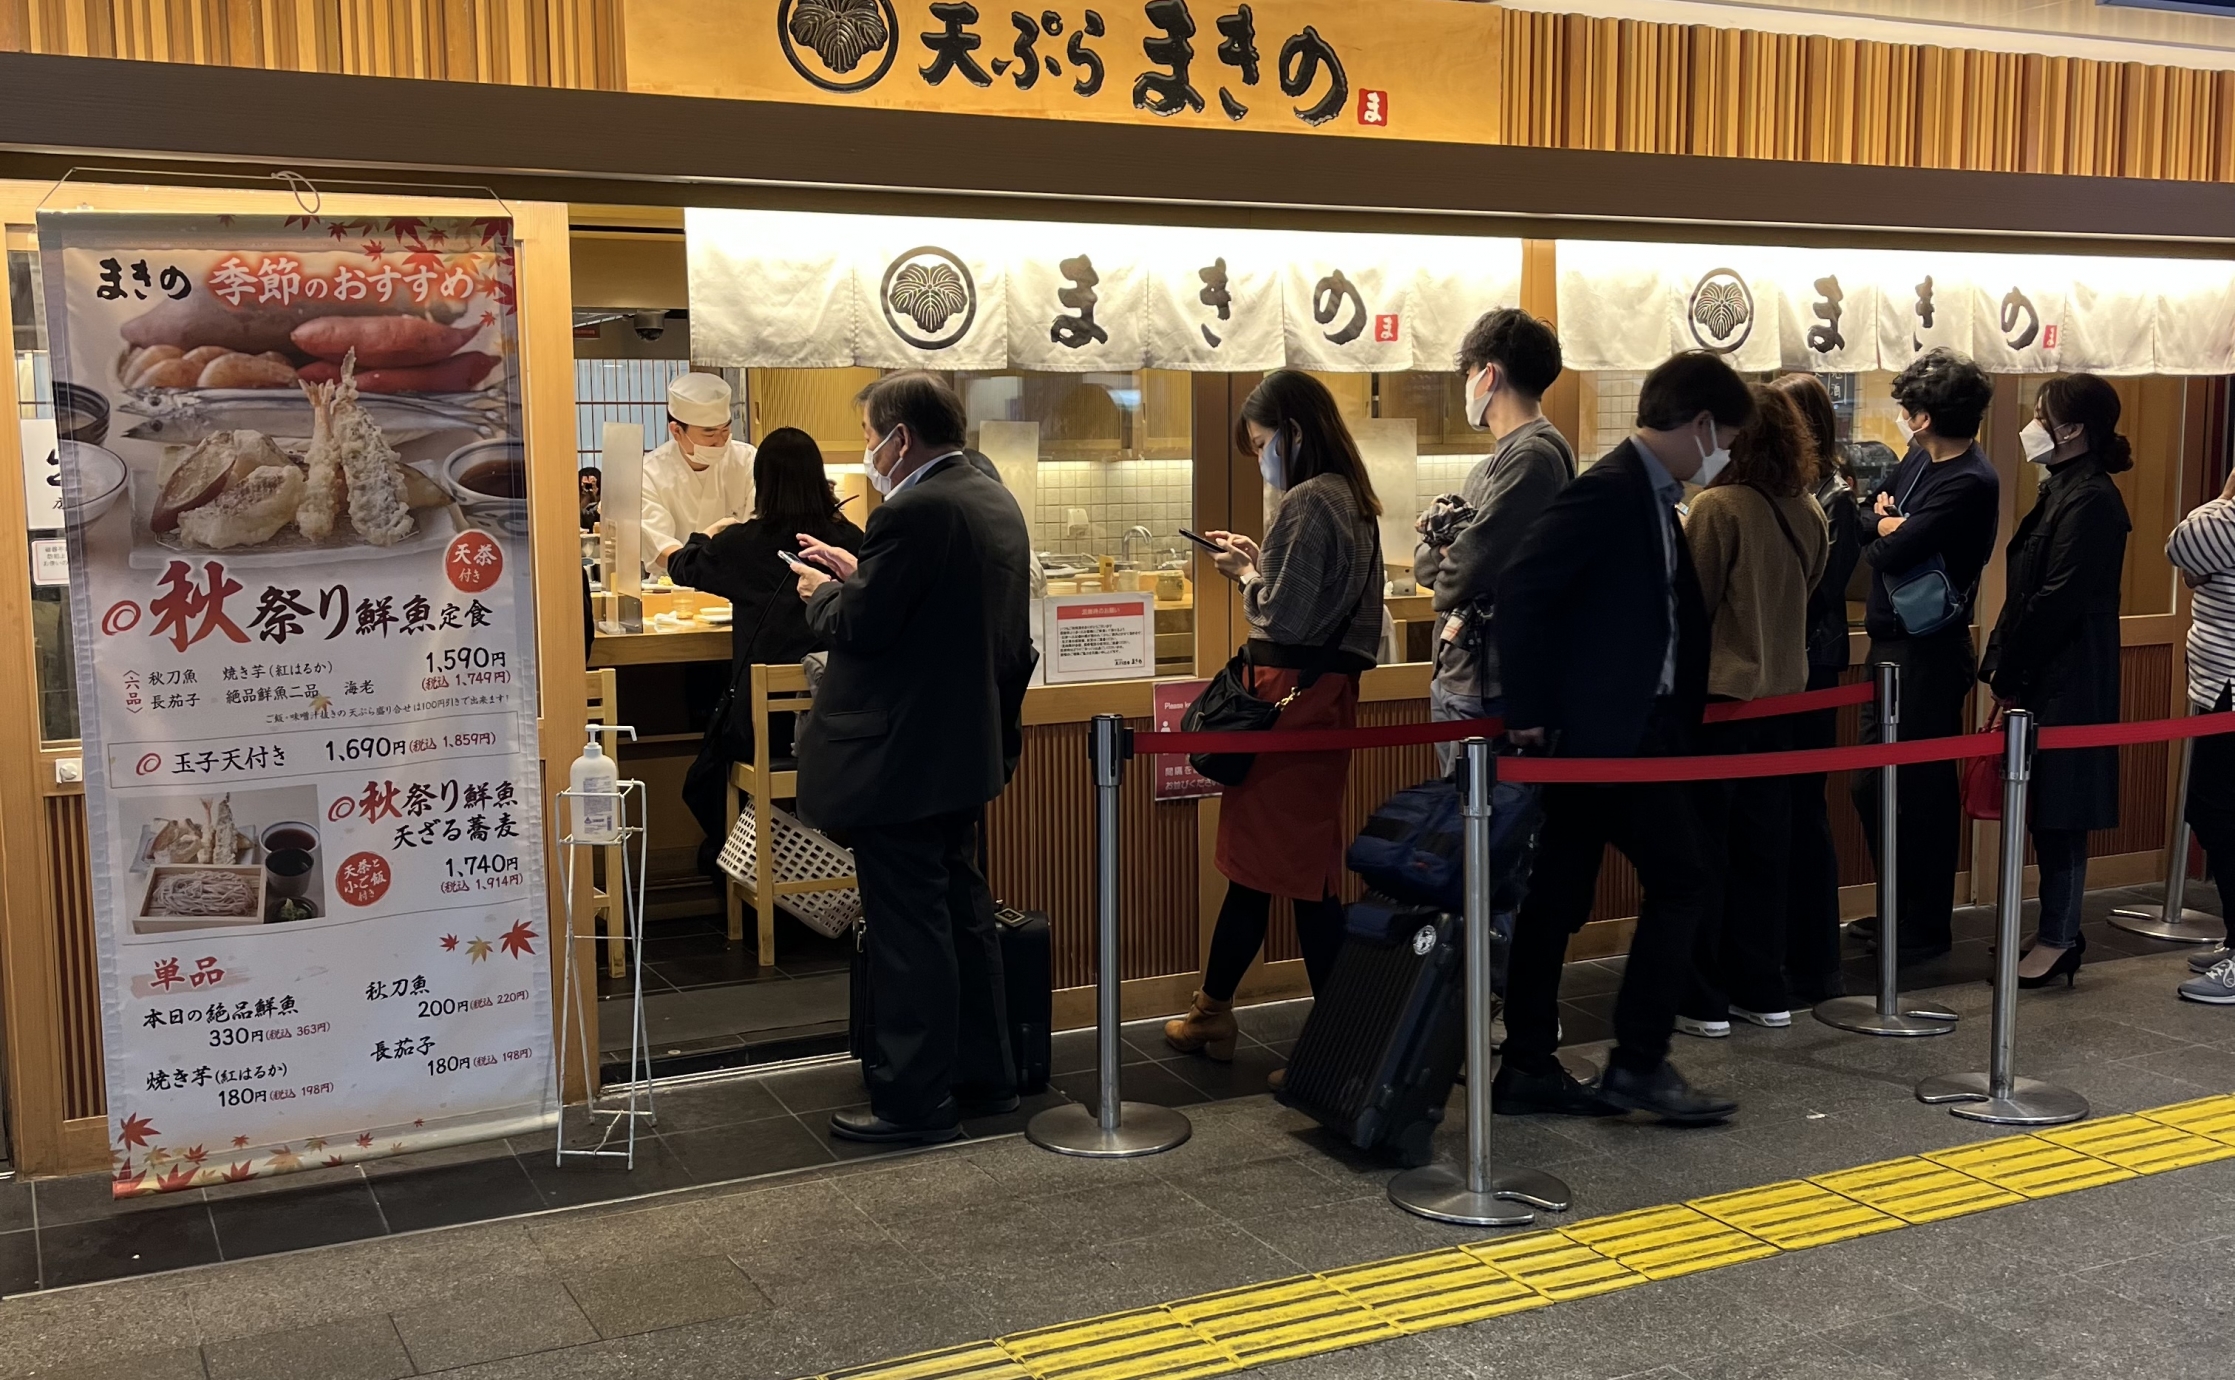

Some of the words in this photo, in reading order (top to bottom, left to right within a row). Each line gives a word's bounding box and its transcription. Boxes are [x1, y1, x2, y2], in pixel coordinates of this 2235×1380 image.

[919, 1, 1105, 97] 天ぷら
[1131, 0, 1349, 127] まきの
[97, 258, 192, 300] まきの
[208, 257, 474, 306] 季節のおすすめ
[148, 668, 198, 686] 秋刀魚
[150, 692, 200, 710] 長茄子
[225, 683, 320, 705] 絶品鮮魚二品
[343, 679, 375, 696] 海老
[1165, 702, 1184, 710] Please
[171, 744, 286, 775] 玉子天付き
[358, 779, 519, 825] 秋祭り鮮魚
[391, 811, 520, 851] 天ざる蕎麦
[150, 956, 226, 991] 単品
[365, 974, 430, 1001] 秋刀魚
[142, 994, 299, 1029] 本日の絶品鮮魚
[418, 998, 469, 1018] 200円
[208, 1027, 264, 1047] 330円
[370, 1035, 436, 1063] 長茄子
[427, 1055, 471, 1077] 180円
[218, 1087, 267, 1108] 180円
